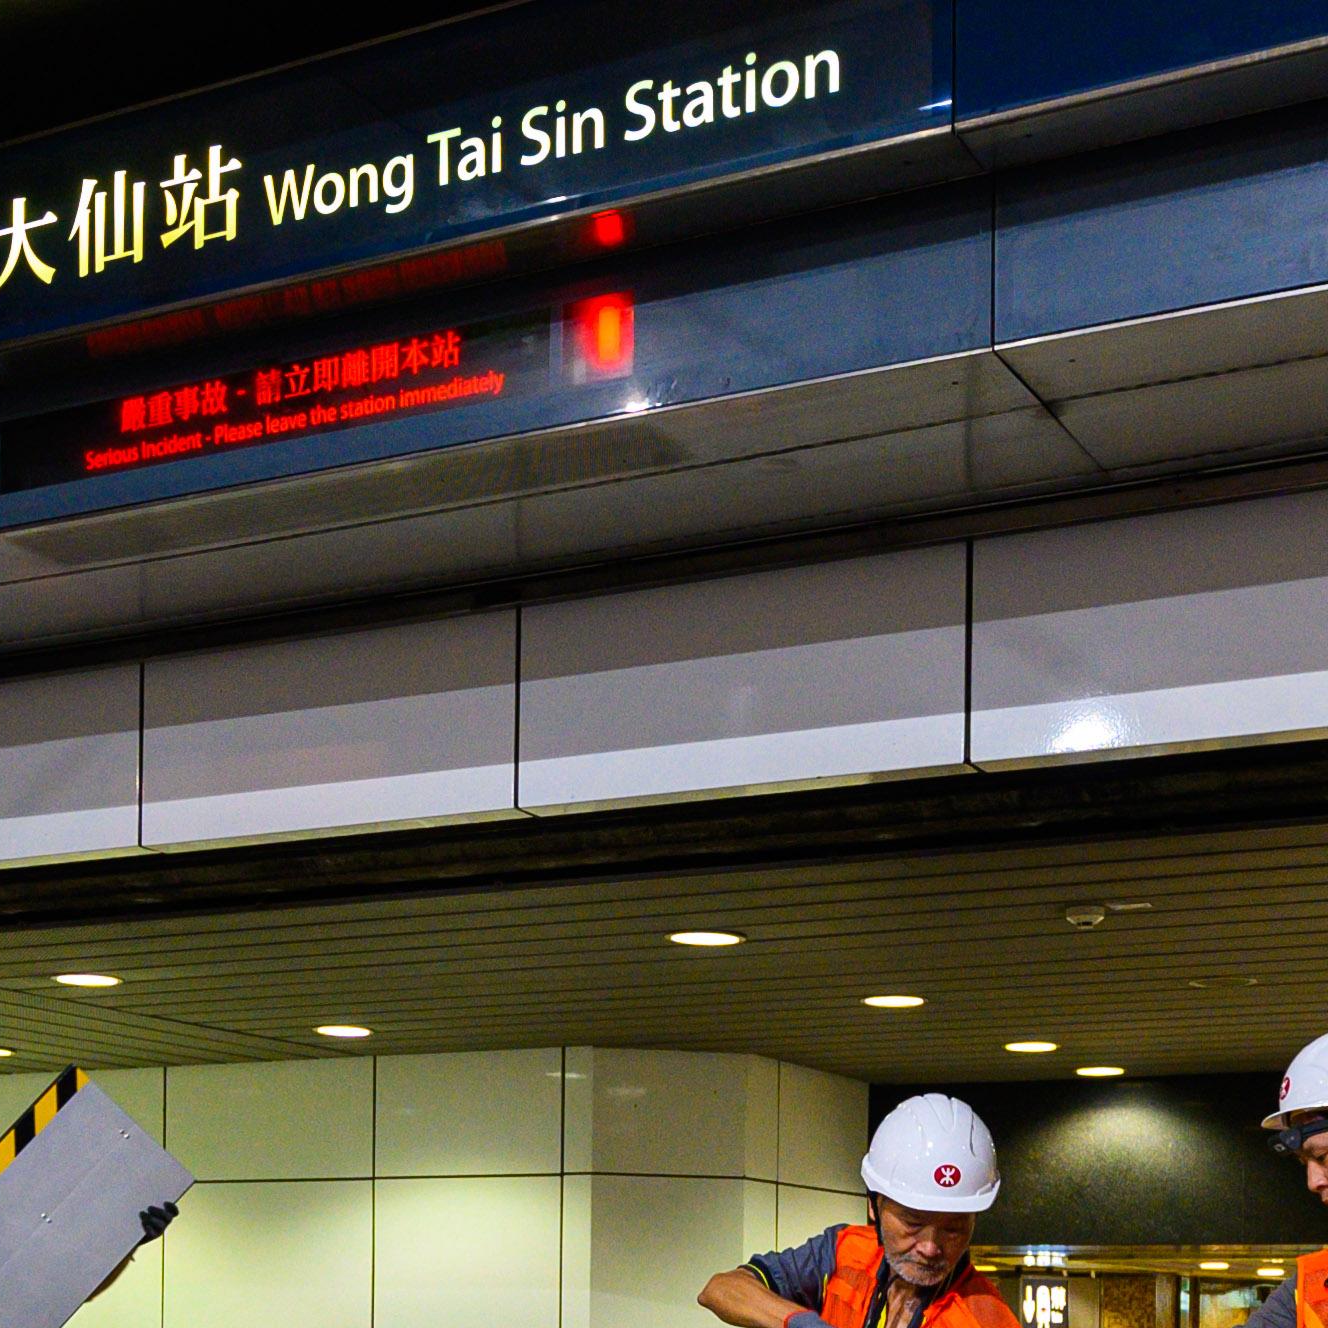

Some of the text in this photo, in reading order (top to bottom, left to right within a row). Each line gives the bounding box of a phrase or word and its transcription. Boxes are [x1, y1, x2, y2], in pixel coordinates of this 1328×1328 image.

[263, 50, 841, 226] Wong Tai Sin Station
[85, 446, 140, 471] Serious
[141, 432, 203, 460] Incident
[213, 421, 263, 446] Please
[266, 411, 308, 436] leave
[310, 403, 337, 426] the
[340, 394, 396, 421] station
[399, 369, 506, 410] immediately
